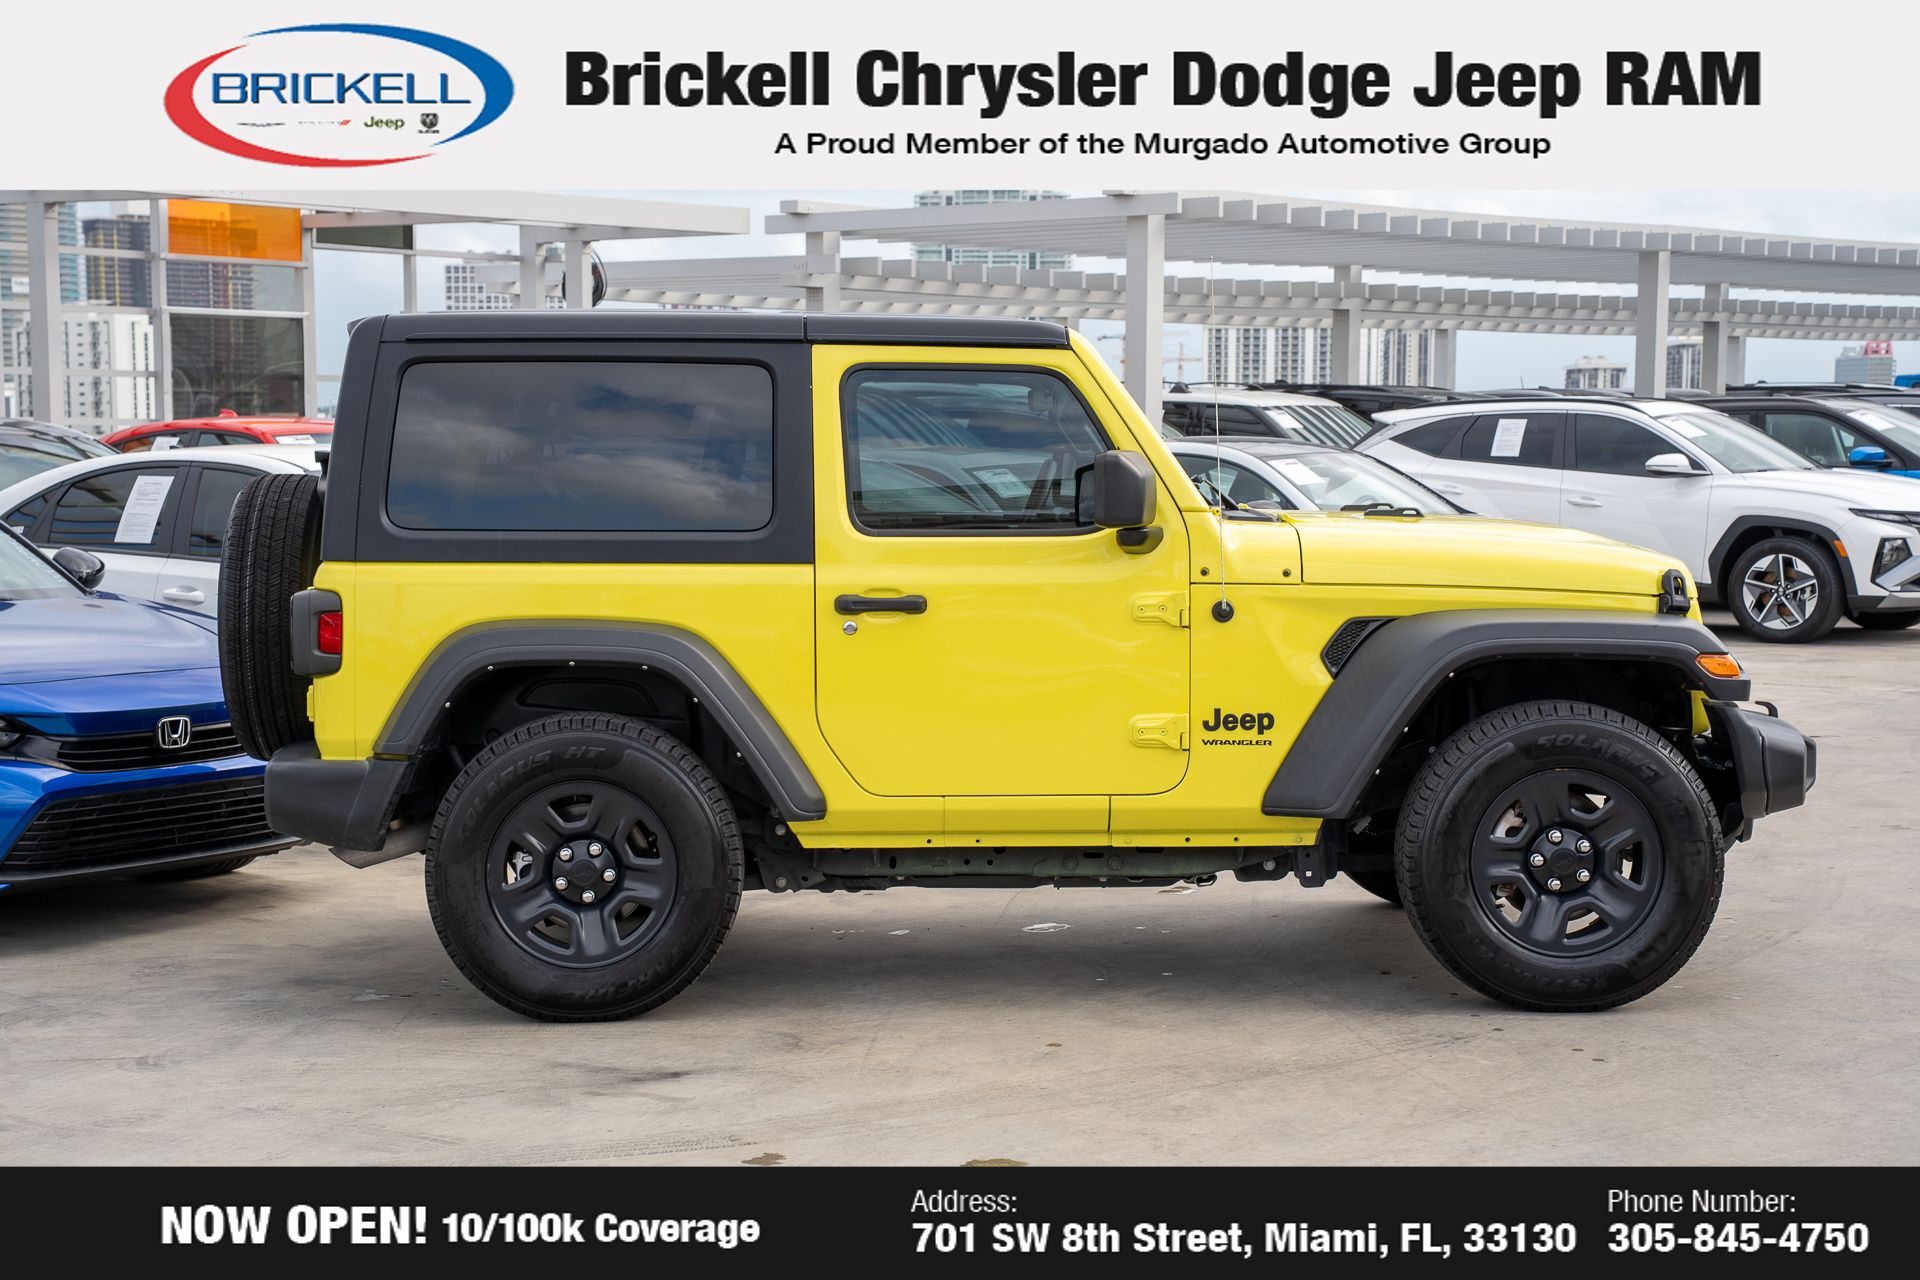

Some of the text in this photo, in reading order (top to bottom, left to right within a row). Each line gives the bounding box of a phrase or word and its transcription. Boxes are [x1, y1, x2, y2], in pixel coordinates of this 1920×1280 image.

[1202, 707, 1275, 736] Jeep
[1201, 738, 1273, 747] WRANGLER
[562, 745, 607, 761] HT
